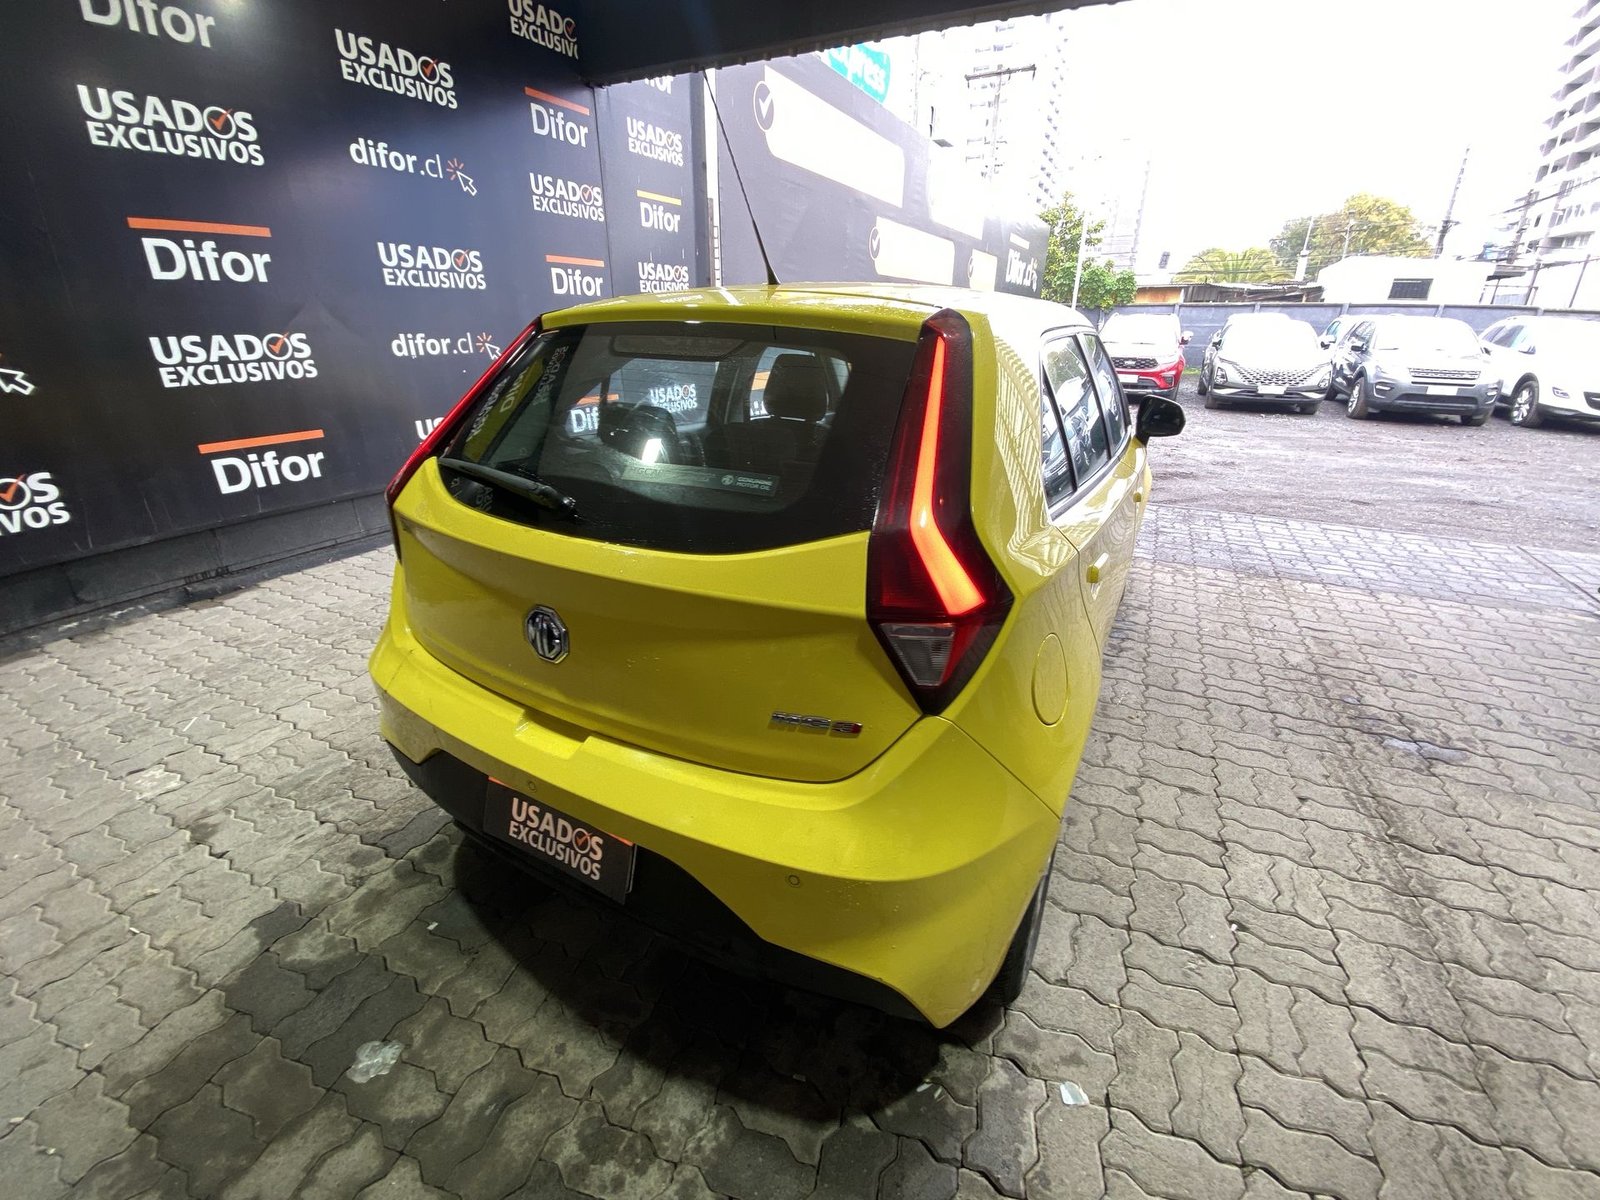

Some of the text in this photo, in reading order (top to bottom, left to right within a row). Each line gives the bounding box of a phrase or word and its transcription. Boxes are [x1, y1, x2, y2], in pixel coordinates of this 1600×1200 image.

[79, 0, 215, 48] Difor
[508, 0, 577, 42] USADO
[510, 16, 578, 60] EXCLUSIV
[334, 28, 454, 88] USADOS
[340, 58, 458, 110] EXCLUSIVOS
[77, 84, 258, 142] USADOS
[530, 102, 589, 148] Difor
[86, 121, 265, 167] EXCLUSIVOS
[627, 116, 682, 151] USADOS
[349, 138, 444, 179] difor.cl
[628, 138, 684, 167] EXCLUSIVOS
[529, 172, 603, 207] USADOS
[532, 196, 605, 222] EXCLUSIVOS
[640, 202, 681, 233] Difor
[141, 237, 271, 283] Difor
[377, 242, 483, 274] USADOS
[638, 261, 689, 283] USADOS
[383, 268, 487, 291] EXCLUSIVOS
[550, 267, 604, 297] Difor
[149, 332, 311, 366] USADOS
[391, 332, 474, 358] difor.cl
[159, 359, 318, 388] EXCLUSIVOS
[649, 384, 697, 405] USADOS
[570, 407, 600, 433] Dif
[211, 451, 325, 495] Difor
[511, 797, 604, 861] USADOS
[508, 820, 602, 881] EXCLUSIVOS
